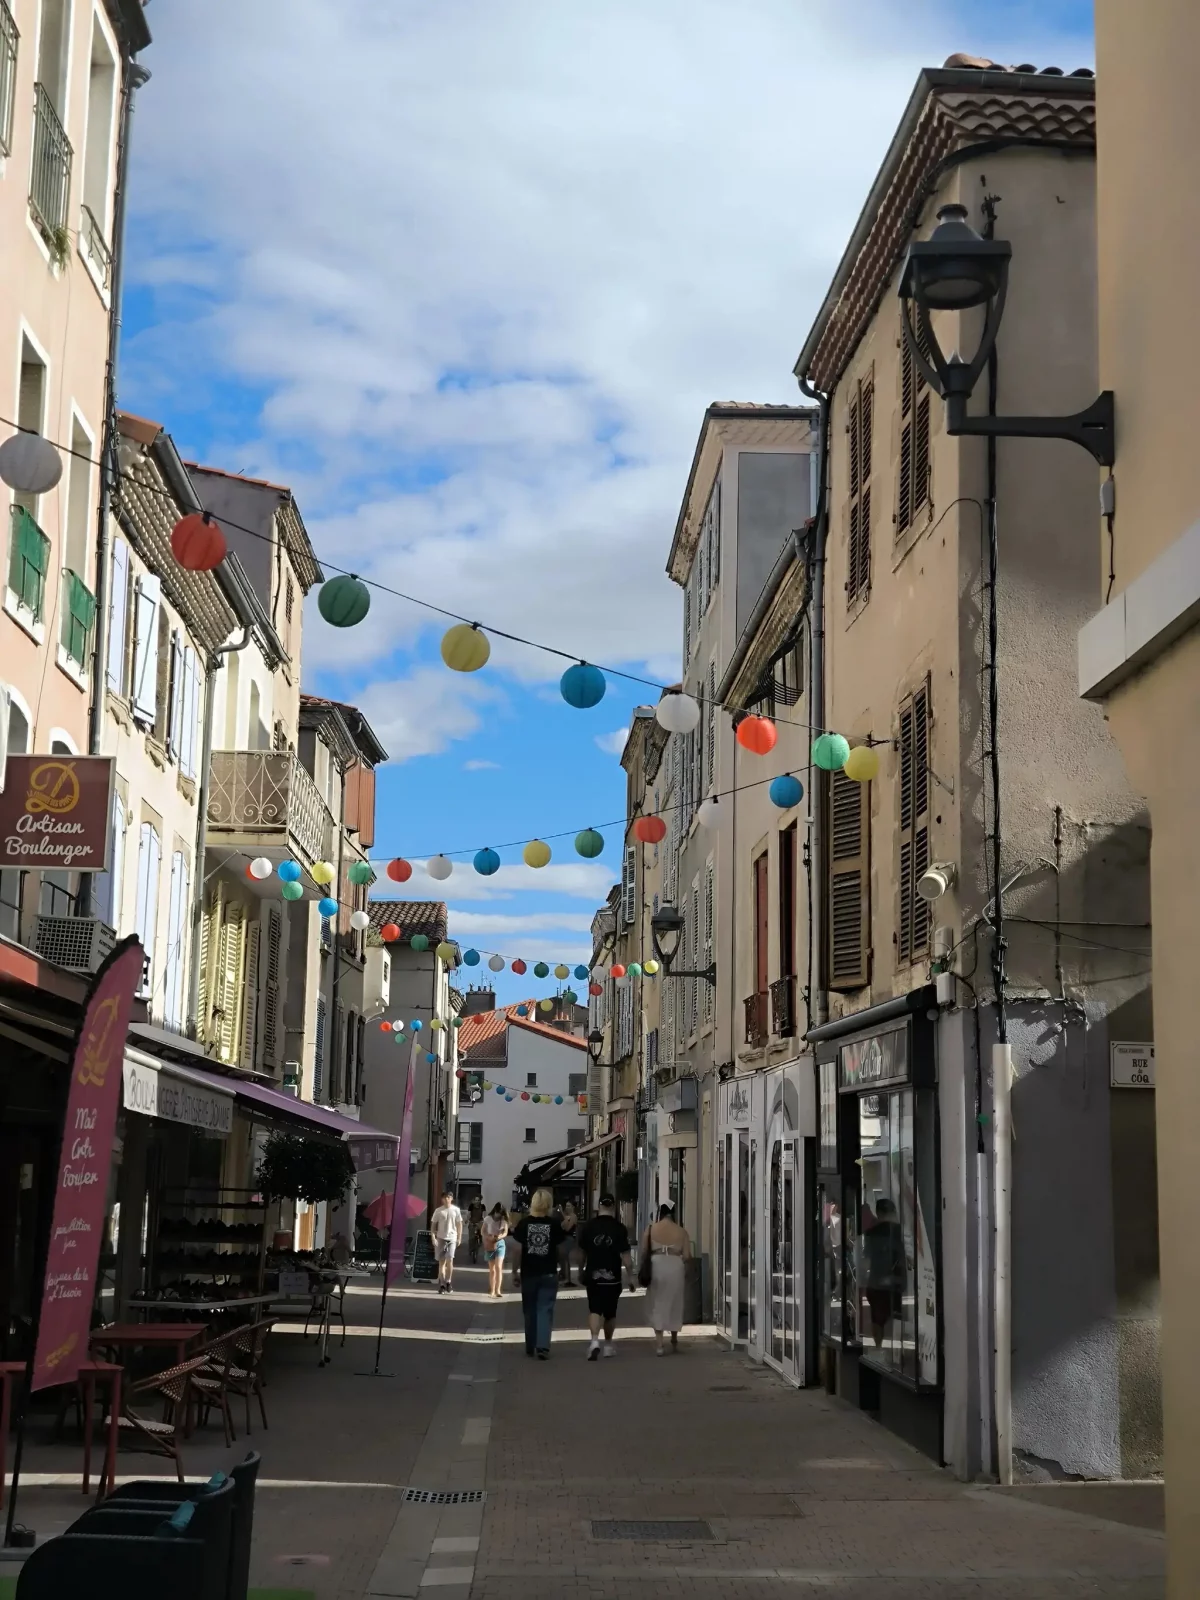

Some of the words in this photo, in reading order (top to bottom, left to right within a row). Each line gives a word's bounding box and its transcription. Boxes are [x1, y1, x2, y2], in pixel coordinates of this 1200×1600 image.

[15, 814, 85, 834] Artisan
[4, 835, 93, 864] Boulanger
[1132, 1058, 1148, 1068] RUE
[1131, 1074, 1149, 1083] COQ
